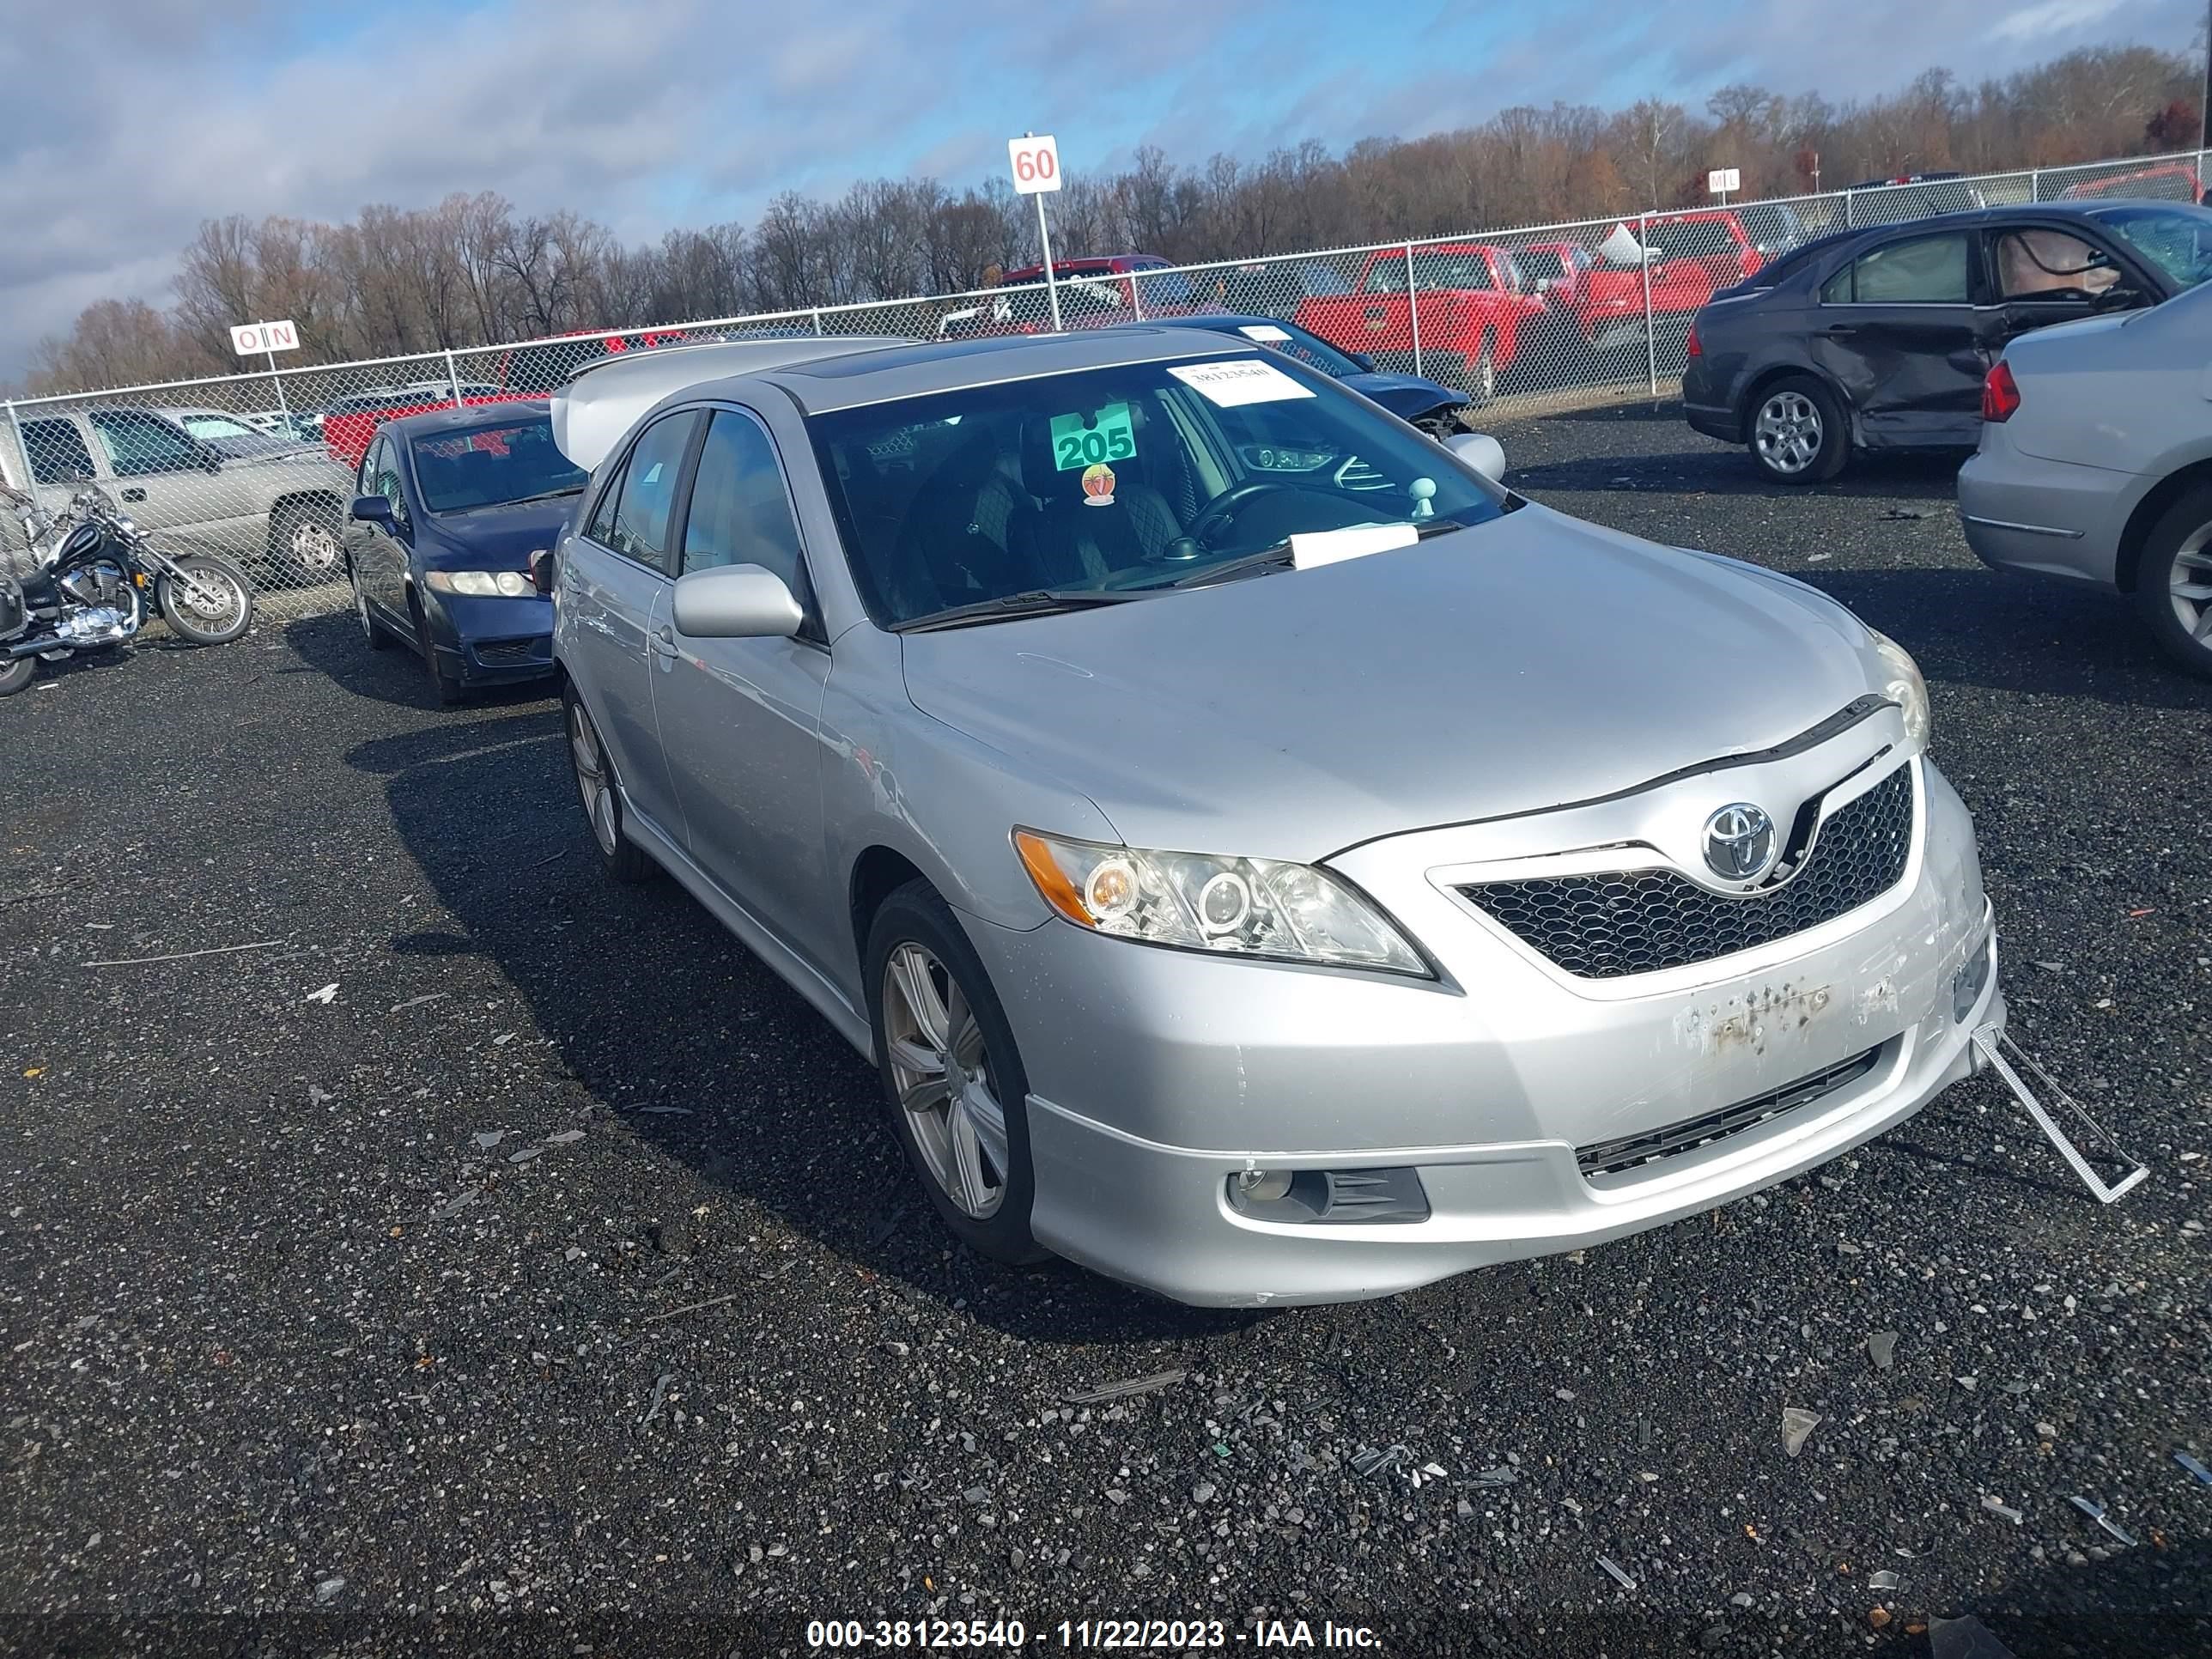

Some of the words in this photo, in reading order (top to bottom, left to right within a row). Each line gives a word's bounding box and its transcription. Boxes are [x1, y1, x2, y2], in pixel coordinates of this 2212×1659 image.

[1017, 149, 1054, 181] 60
[273, 326, 292, 345] N
[1058, 426, 1133, 469] 205
